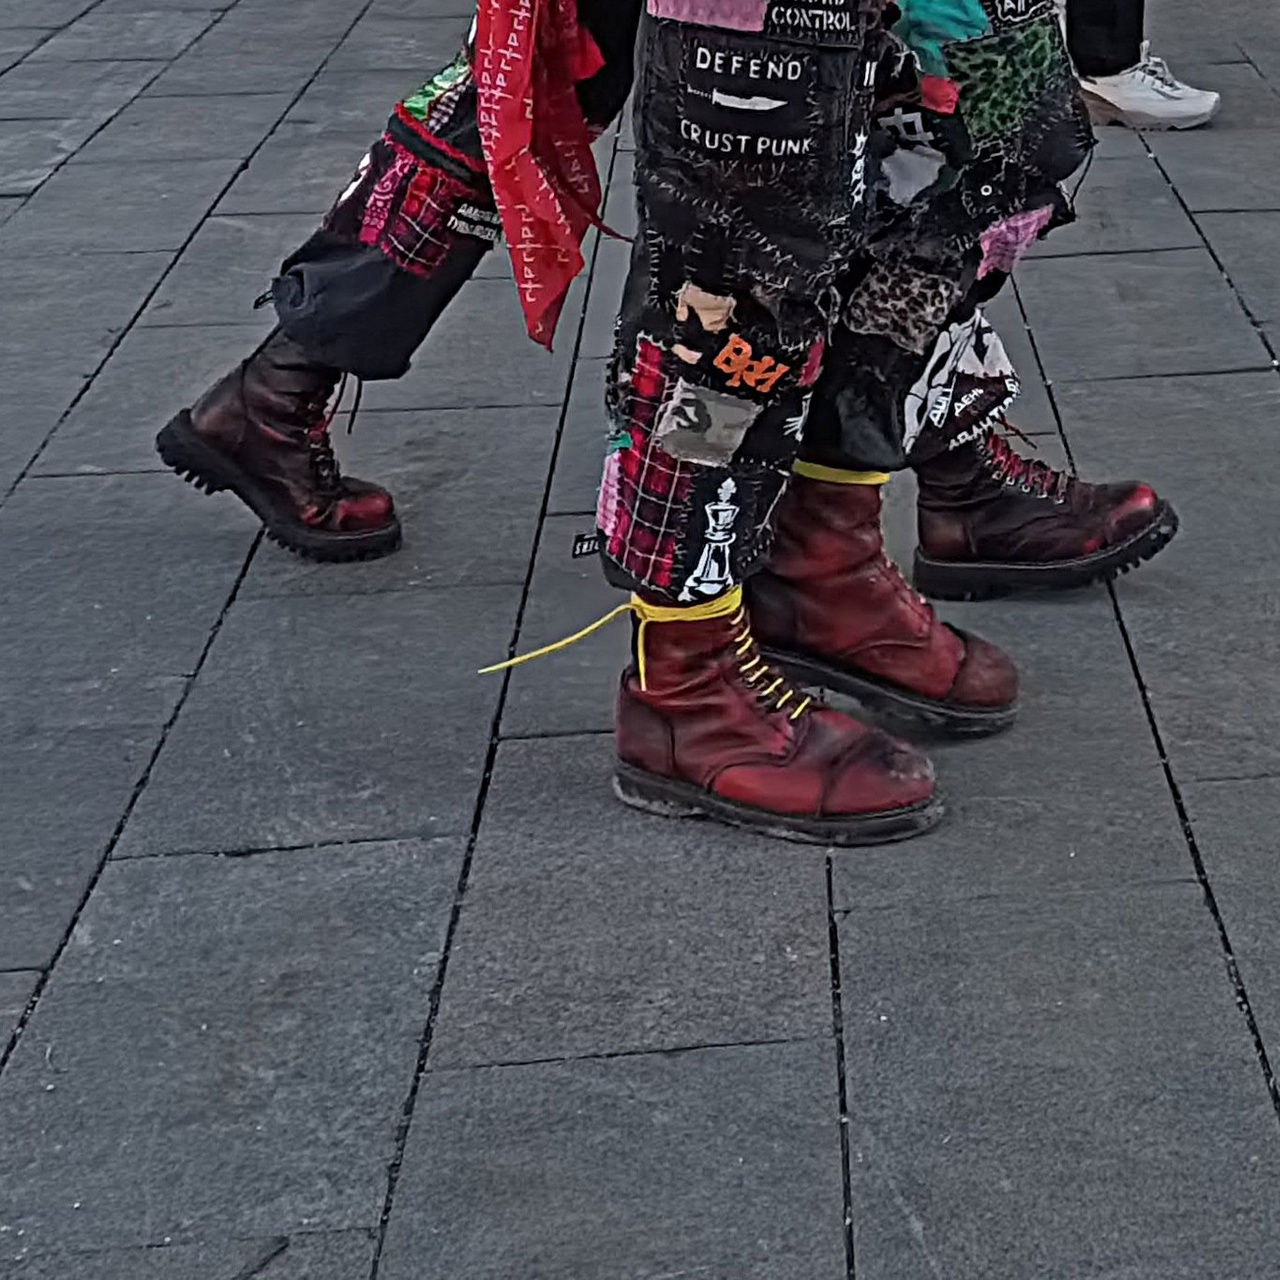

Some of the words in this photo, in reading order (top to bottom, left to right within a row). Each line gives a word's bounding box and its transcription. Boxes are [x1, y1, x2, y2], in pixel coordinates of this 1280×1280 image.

[771, 6, 857, 33] CONTROL
[696, 46, 802, 81] DEFEND
[680, 119, 752, 154] CRUST
[757, 135, 814, 157] PUNK
